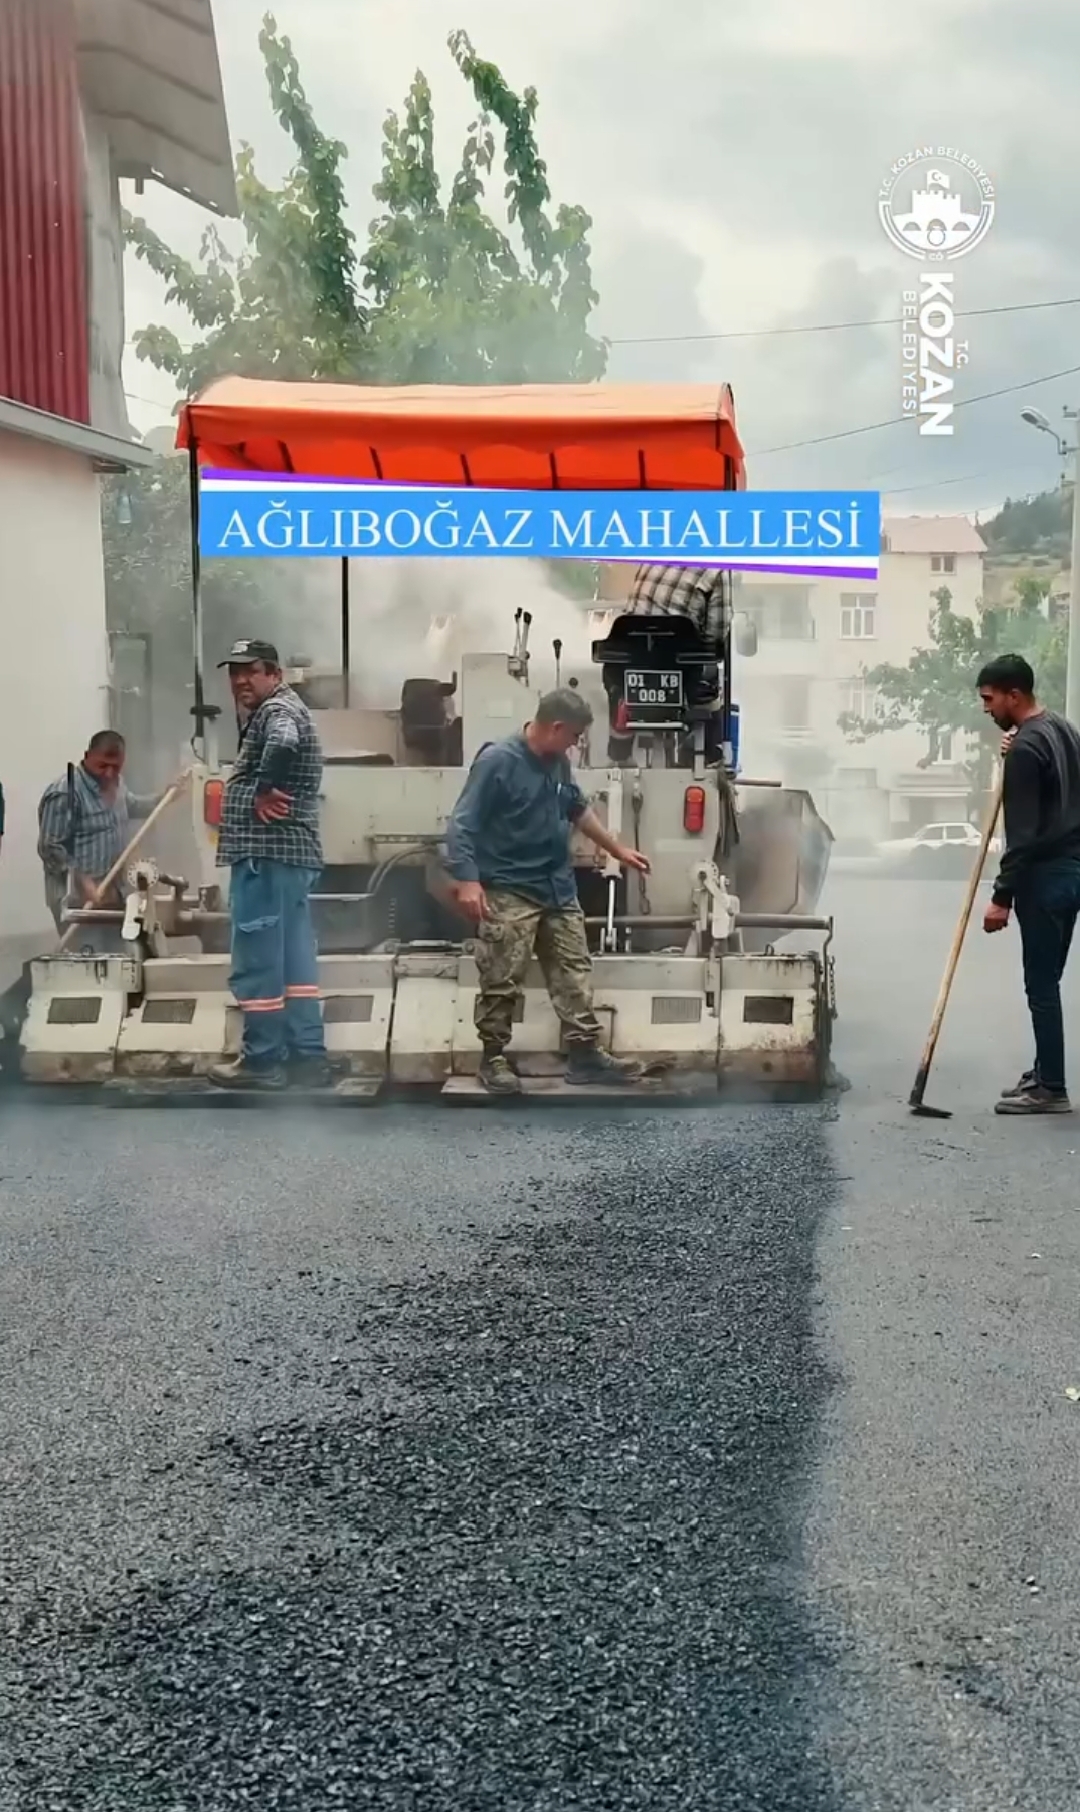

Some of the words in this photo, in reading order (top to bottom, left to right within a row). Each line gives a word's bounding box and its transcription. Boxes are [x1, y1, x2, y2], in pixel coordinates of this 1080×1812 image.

[628, 674, 644, 687] 01
[661, 674, 679, 687] KB
[639, 689, 666, 702] 008
